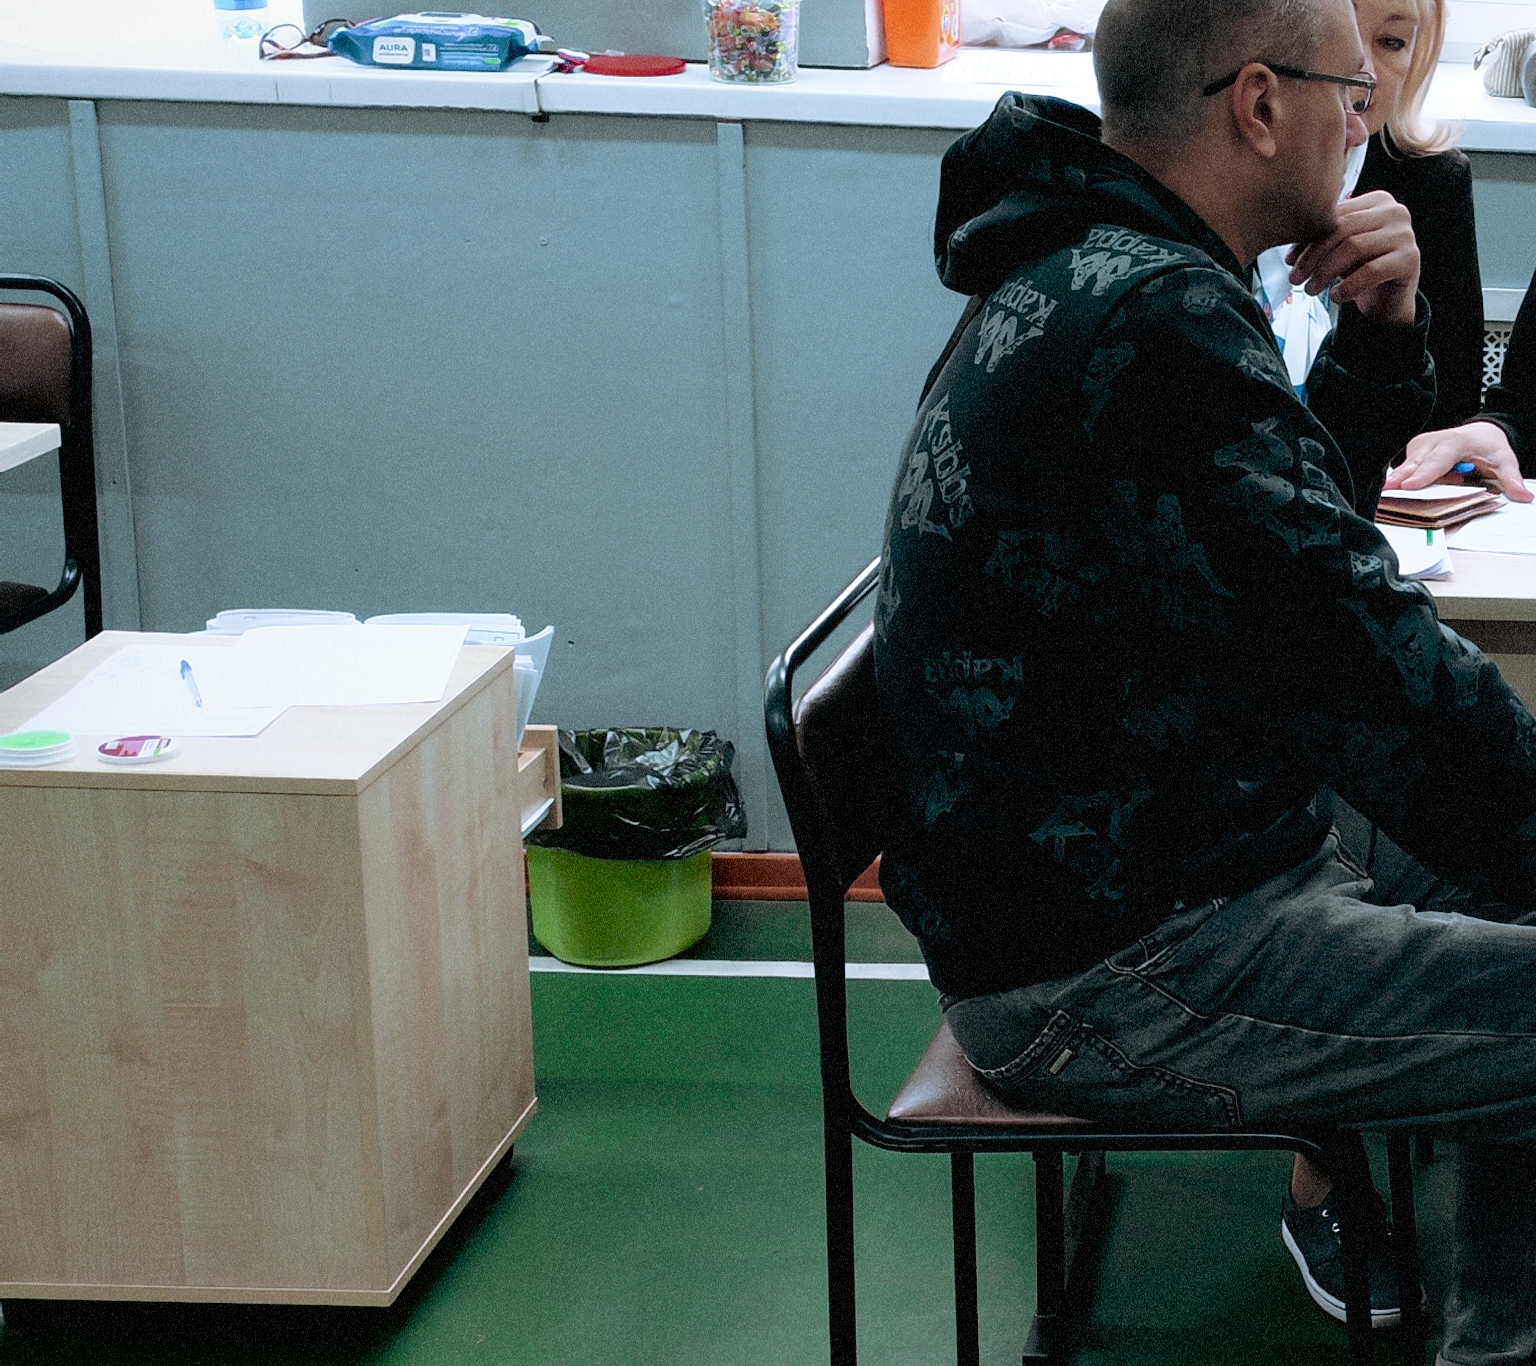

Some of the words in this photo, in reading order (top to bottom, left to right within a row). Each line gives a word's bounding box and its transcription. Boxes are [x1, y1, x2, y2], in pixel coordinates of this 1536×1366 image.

[379, 43, 408, 52] AURA
[1083, 226, 1186, 267] Kappa
[992, 276, 1060, 329] Kapp
